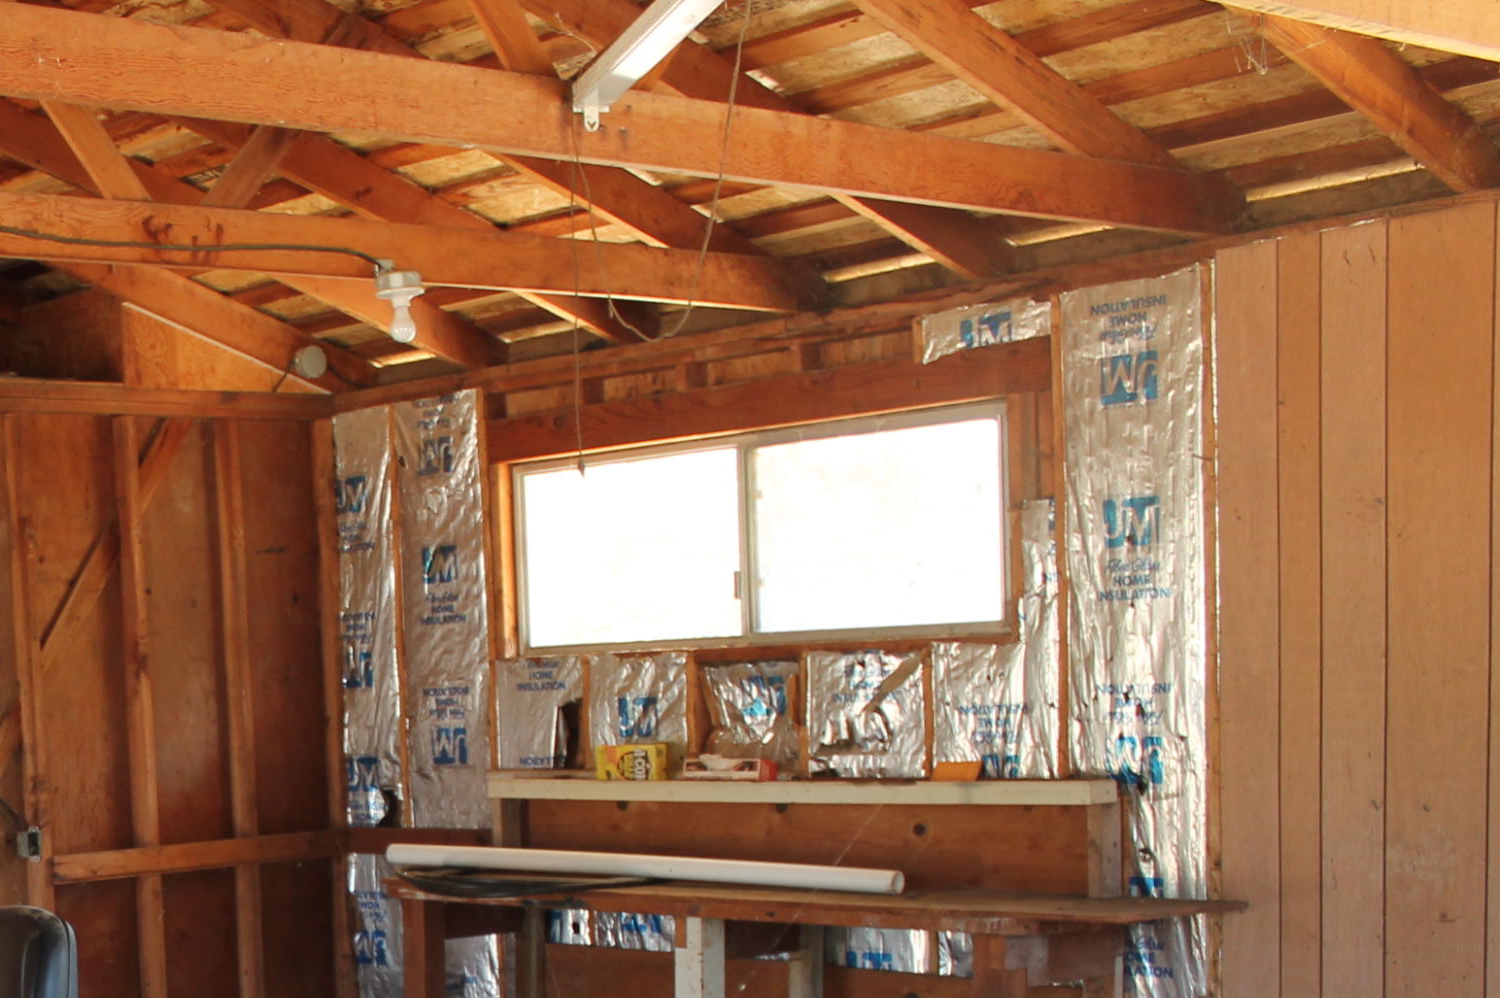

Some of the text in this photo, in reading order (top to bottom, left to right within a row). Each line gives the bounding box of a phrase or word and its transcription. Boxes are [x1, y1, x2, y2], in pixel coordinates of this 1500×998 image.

[1090, 295, 1167, 315] INSULATION
[1100, 350, 1158, 406] JM
[1103, 496, 1160, 549] JM
[1113, 575, 1151, 587] HOME
